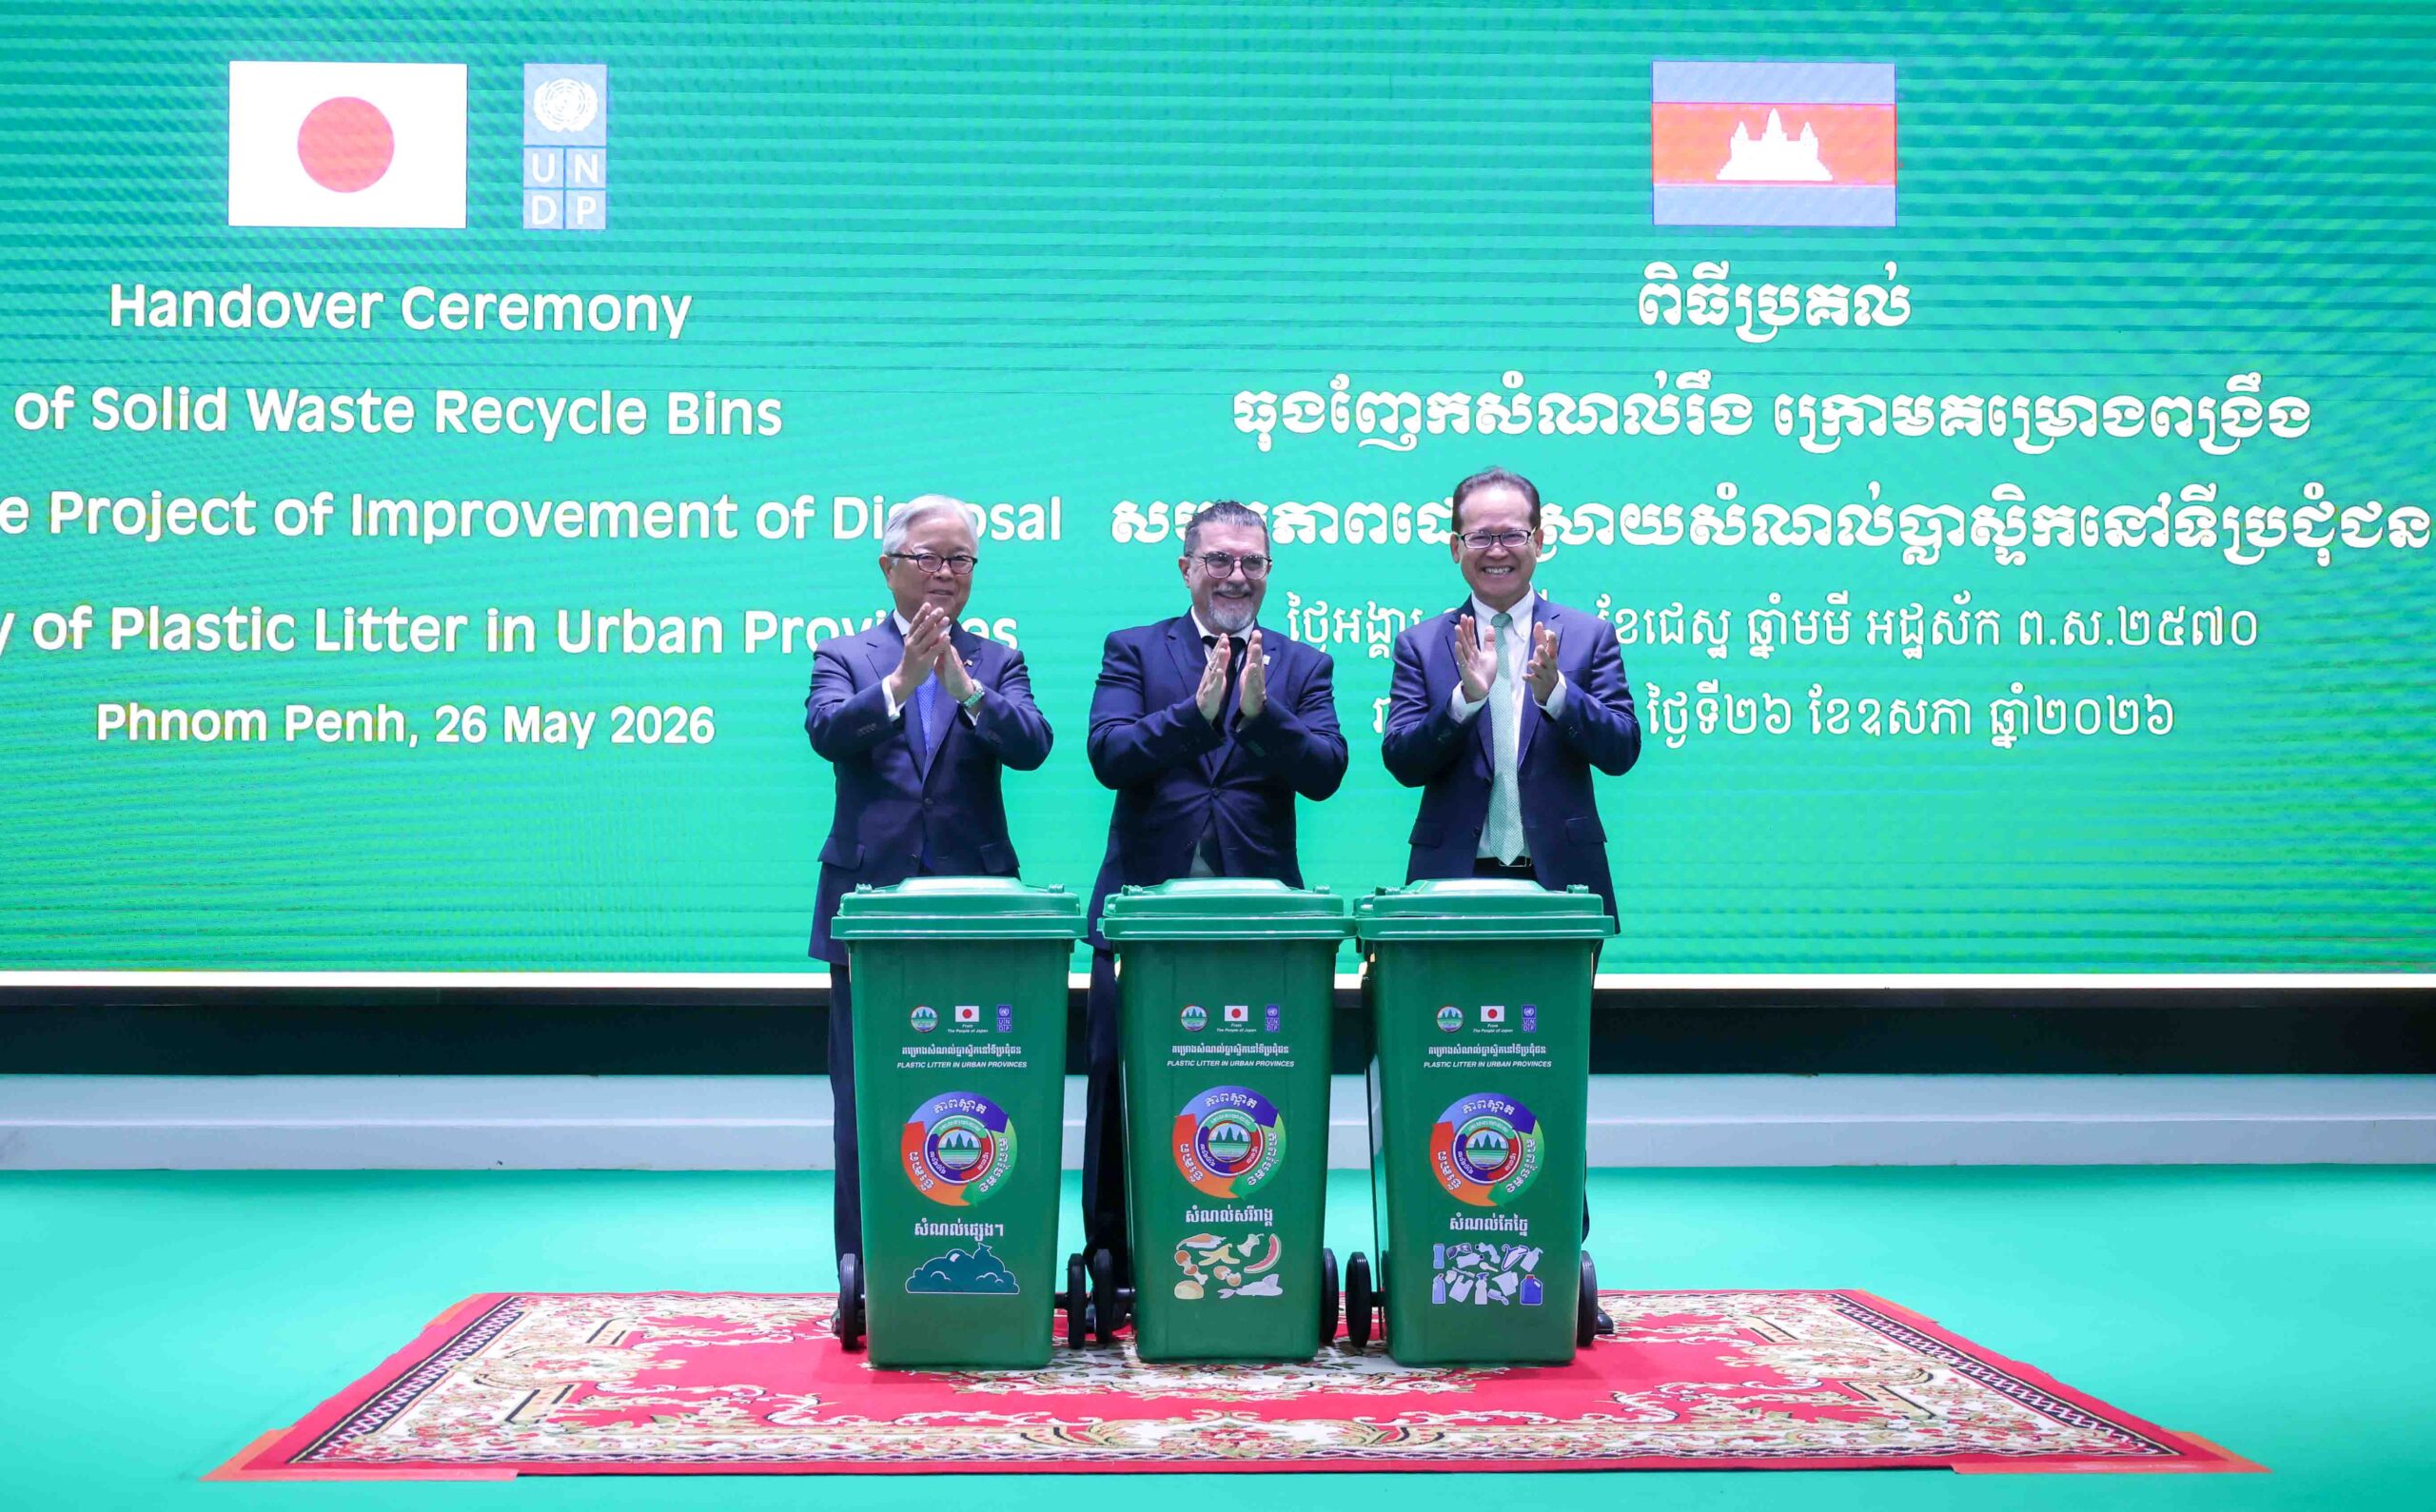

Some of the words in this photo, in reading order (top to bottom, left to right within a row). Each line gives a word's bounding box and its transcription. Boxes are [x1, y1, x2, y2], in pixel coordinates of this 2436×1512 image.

[110, 284, 383, 329] Handover
[402, 285, 692, 339] Ceremony
[1639, 261, 1911, 344] ពិធីប្រគល់
[15, 385, 74, 430] of
[92, 386, 226, 431] Solid
[246, 388, 414, 433] Waste
[436, 390, 647, 442] Recycle
[668, 391, 782, 436] Bins
[1775, 372, 2310, 455] ក្រោមគម្រោងពង្រឹង
[50, 490, 257, 542] Project
[274, 491, 334, 536] of
[352, 494, 738, 544] Improvement
[756, 495, 815, 540] of
[834, 495, 1061, 540] Disal
[33, 605, 92, 650] of
[111, 605, 295, 652] Plastic
[316, 606, 468, 653] Litter
[487, 608, 535, 652] in
[558, 608, 722, 654] Urban
[98, 702, 266, 741] Phnom
[285, 704, 418, 748] Penh,
[436, 705, 487, 743] 26
[504, 706, 596, 749] May
[611, 705, 715, 744] 2026
[1808, 683, 1971, 736] ខែឧសភា
